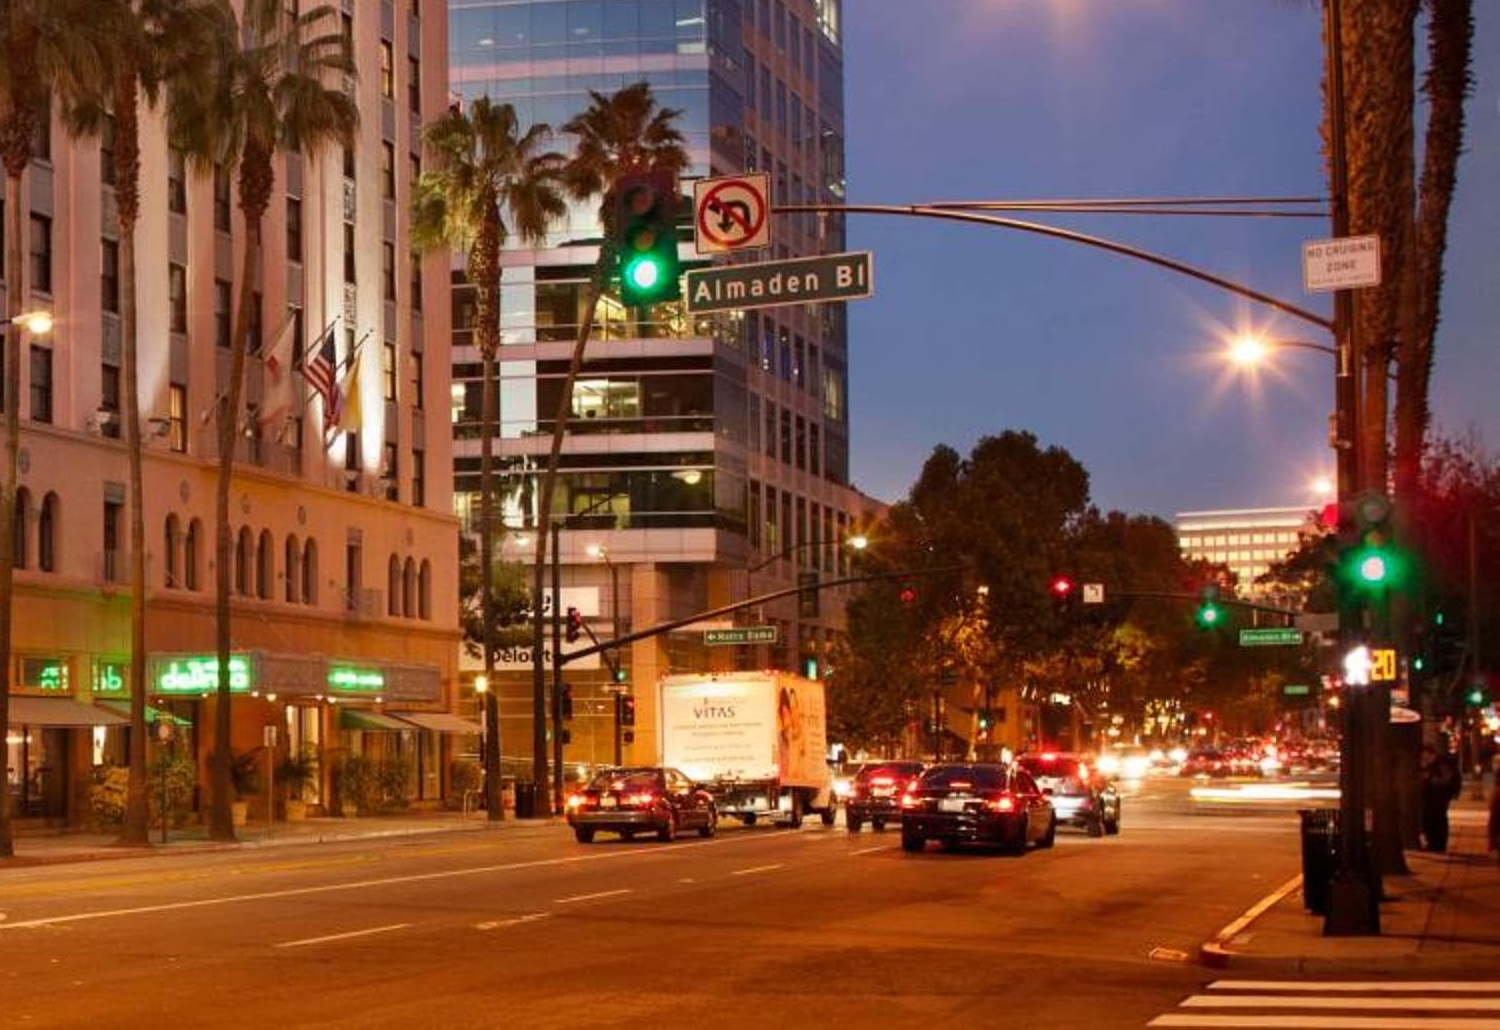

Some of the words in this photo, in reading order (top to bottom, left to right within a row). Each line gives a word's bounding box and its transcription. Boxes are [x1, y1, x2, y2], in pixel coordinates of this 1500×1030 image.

[695, 273, 819, 302] Almaden
[836, 264, 865, 289] Bl
[489, 648, 558, 663] Delot
[1371, 649, 1396, 681] 20
[693, 705, 736, 720] VITAS
